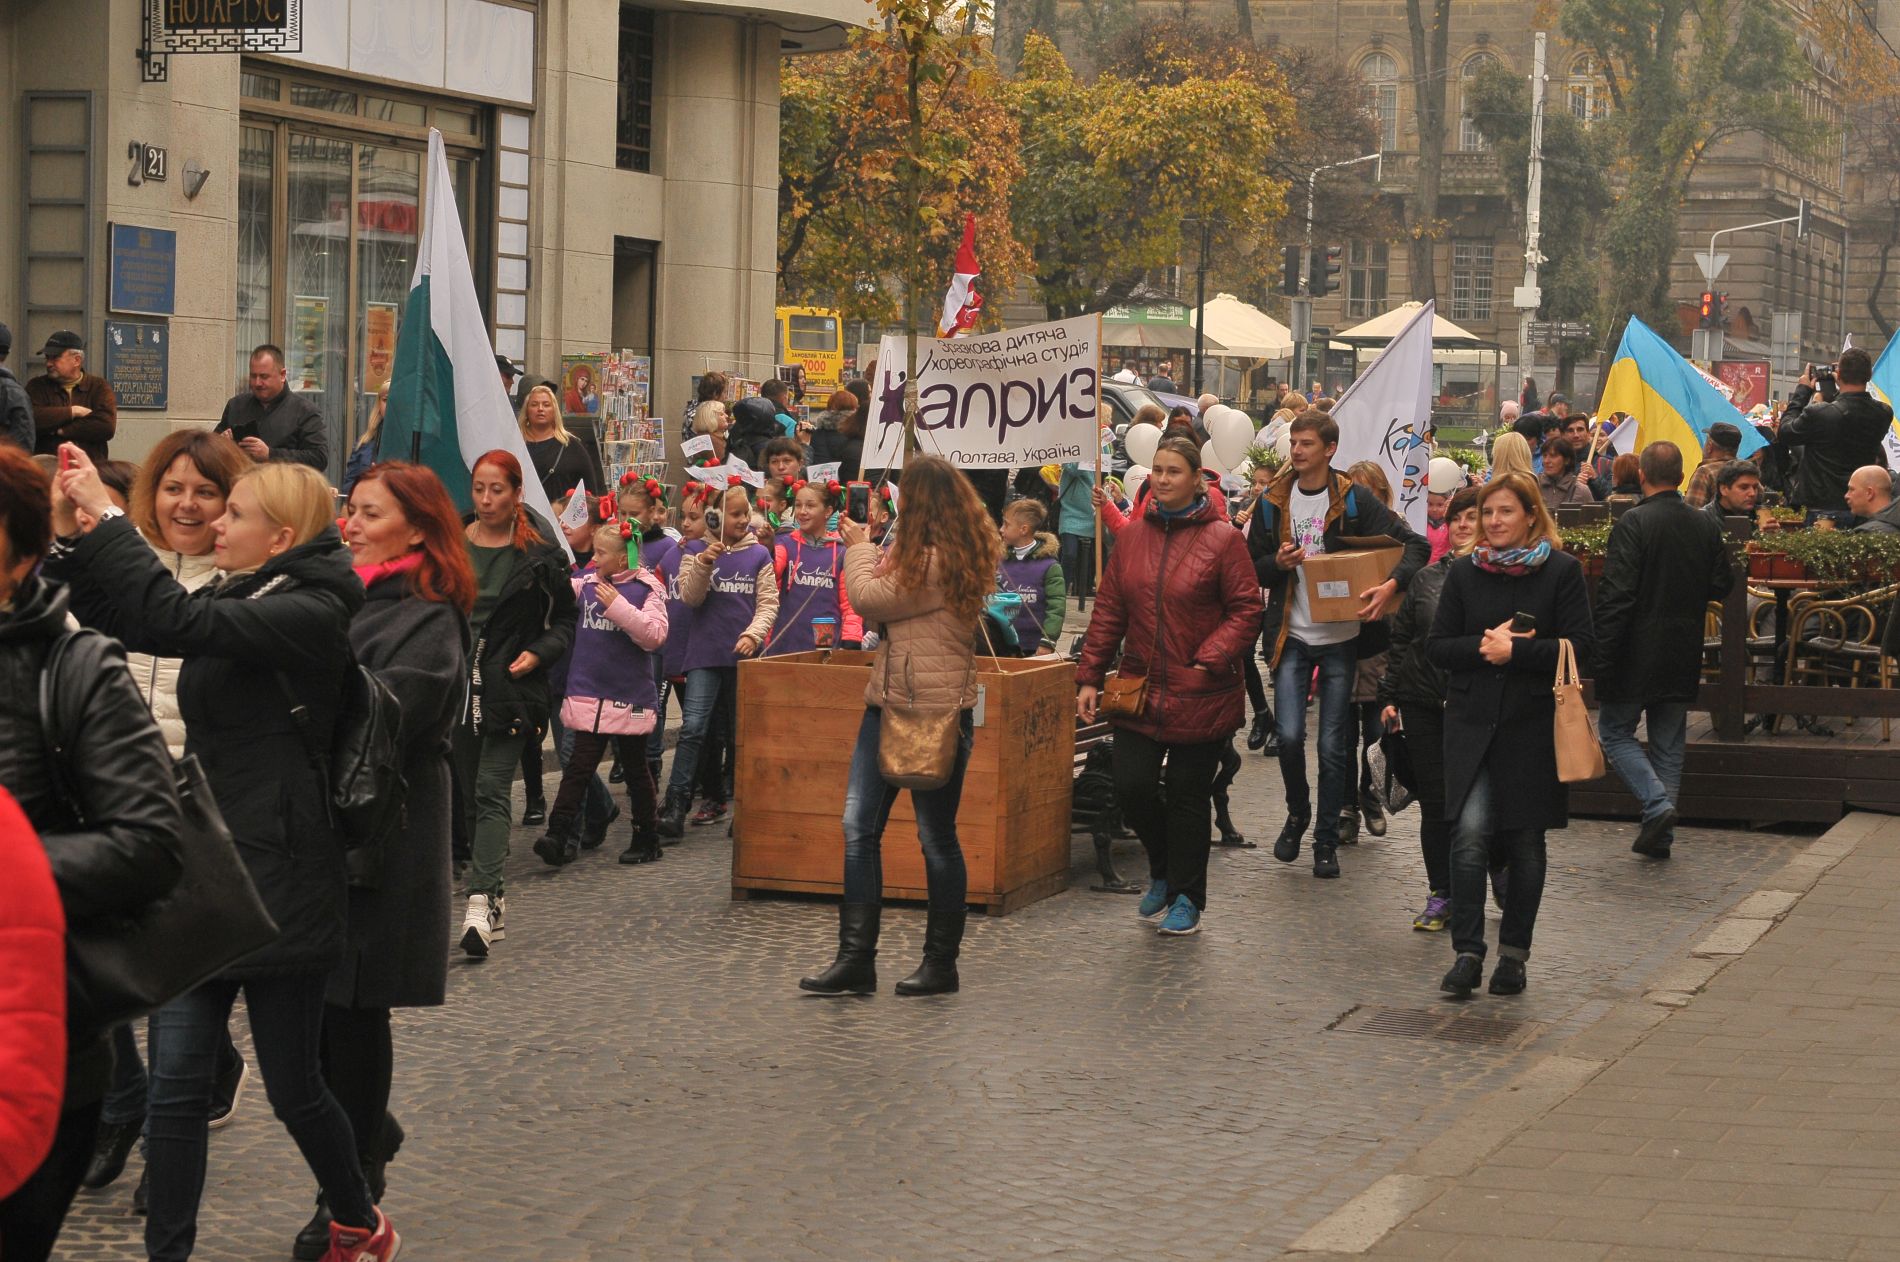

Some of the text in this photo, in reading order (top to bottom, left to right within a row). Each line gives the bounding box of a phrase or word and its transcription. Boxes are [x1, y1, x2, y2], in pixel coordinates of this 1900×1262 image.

[148, 148, 164, 176] 21
[937, 327, 1067, 356] Зразкова дитяча
[803, 359, 827, 372] 7000
[931, 338, 1089, 374] хореографічна студія
[122, 393, 154, 405] КОНТОРА
[950, 443, 1081, 465] Полтава, Україна
